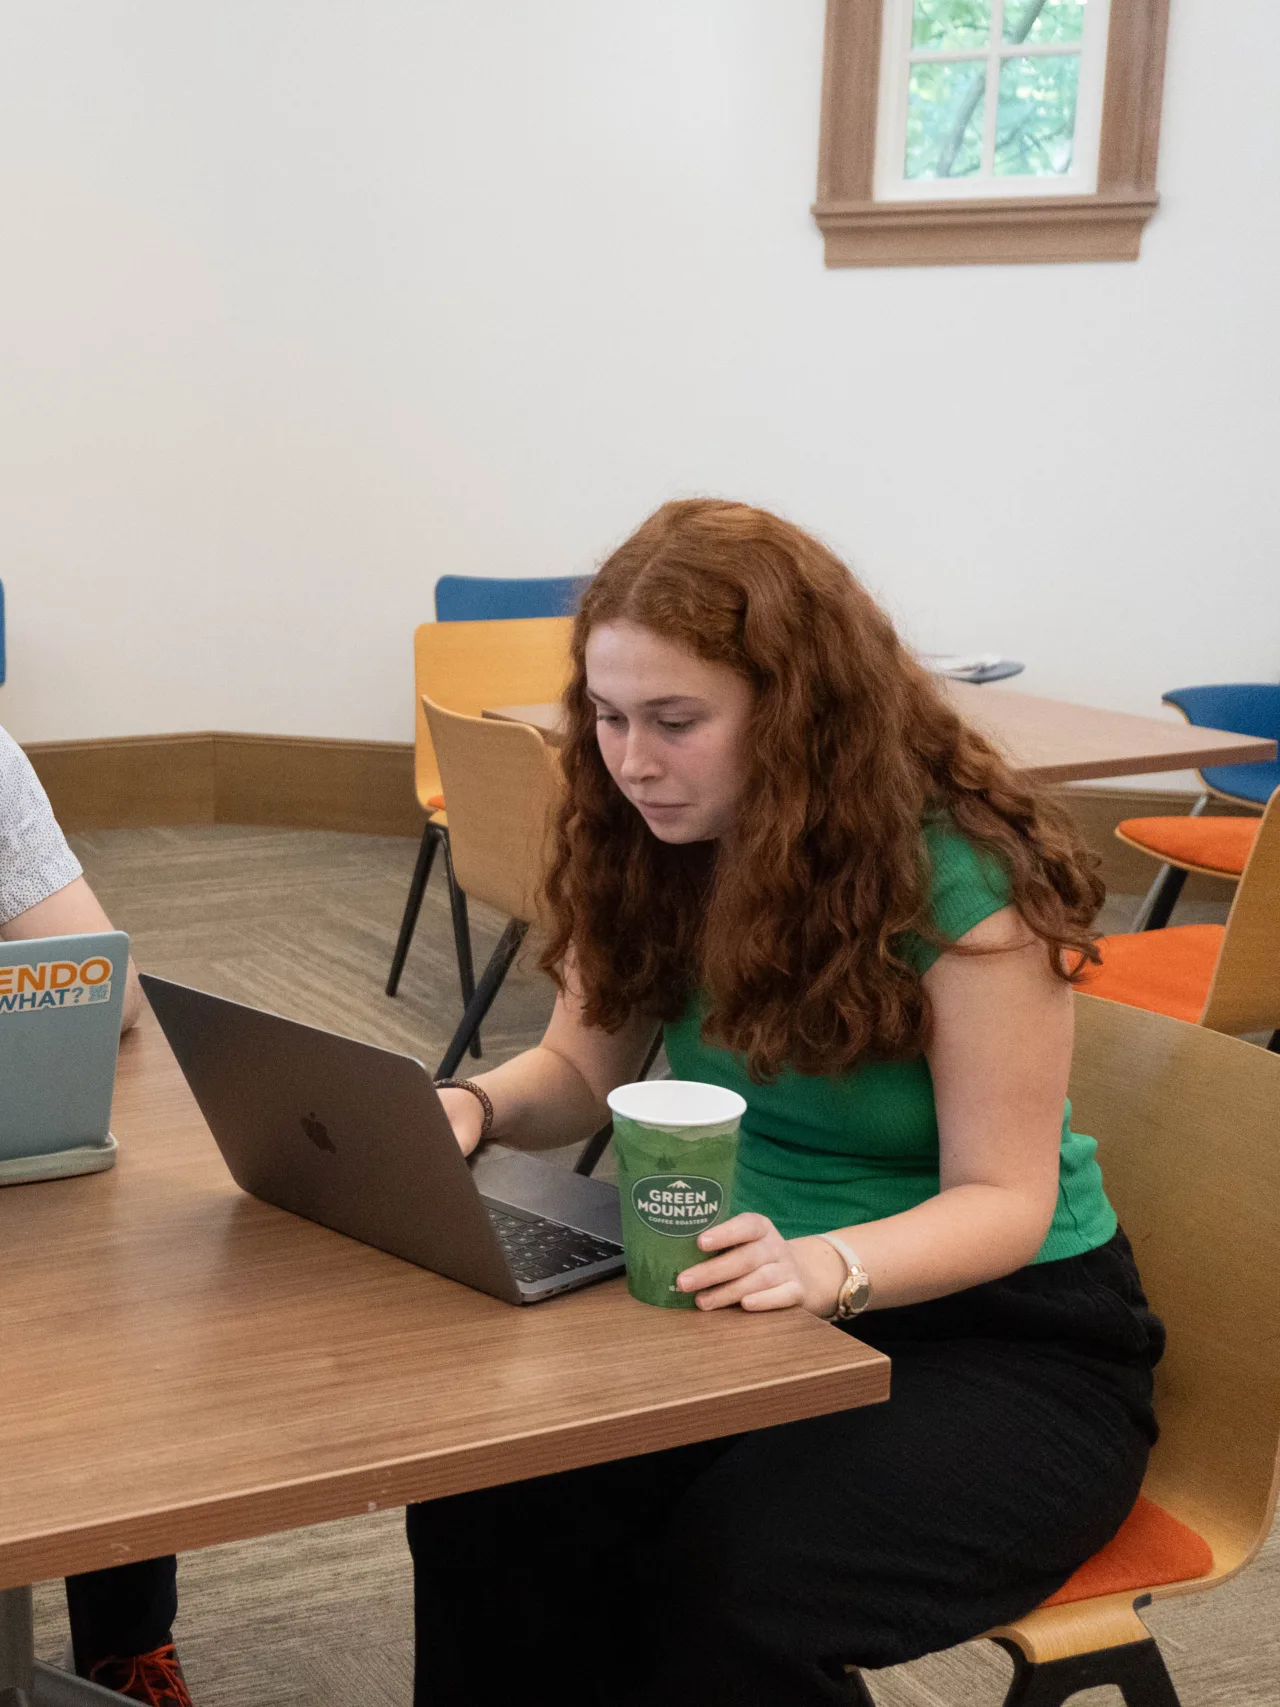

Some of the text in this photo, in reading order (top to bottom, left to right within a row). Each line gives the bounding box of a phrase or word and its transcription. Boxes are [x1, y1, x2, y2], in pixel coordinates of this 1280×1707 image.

[649, 1190, 706, 1204] GREEN
[638, 1199, 718, 1217] MOUNTAIN
[648, 1216, 674, 1225] COFFEE
